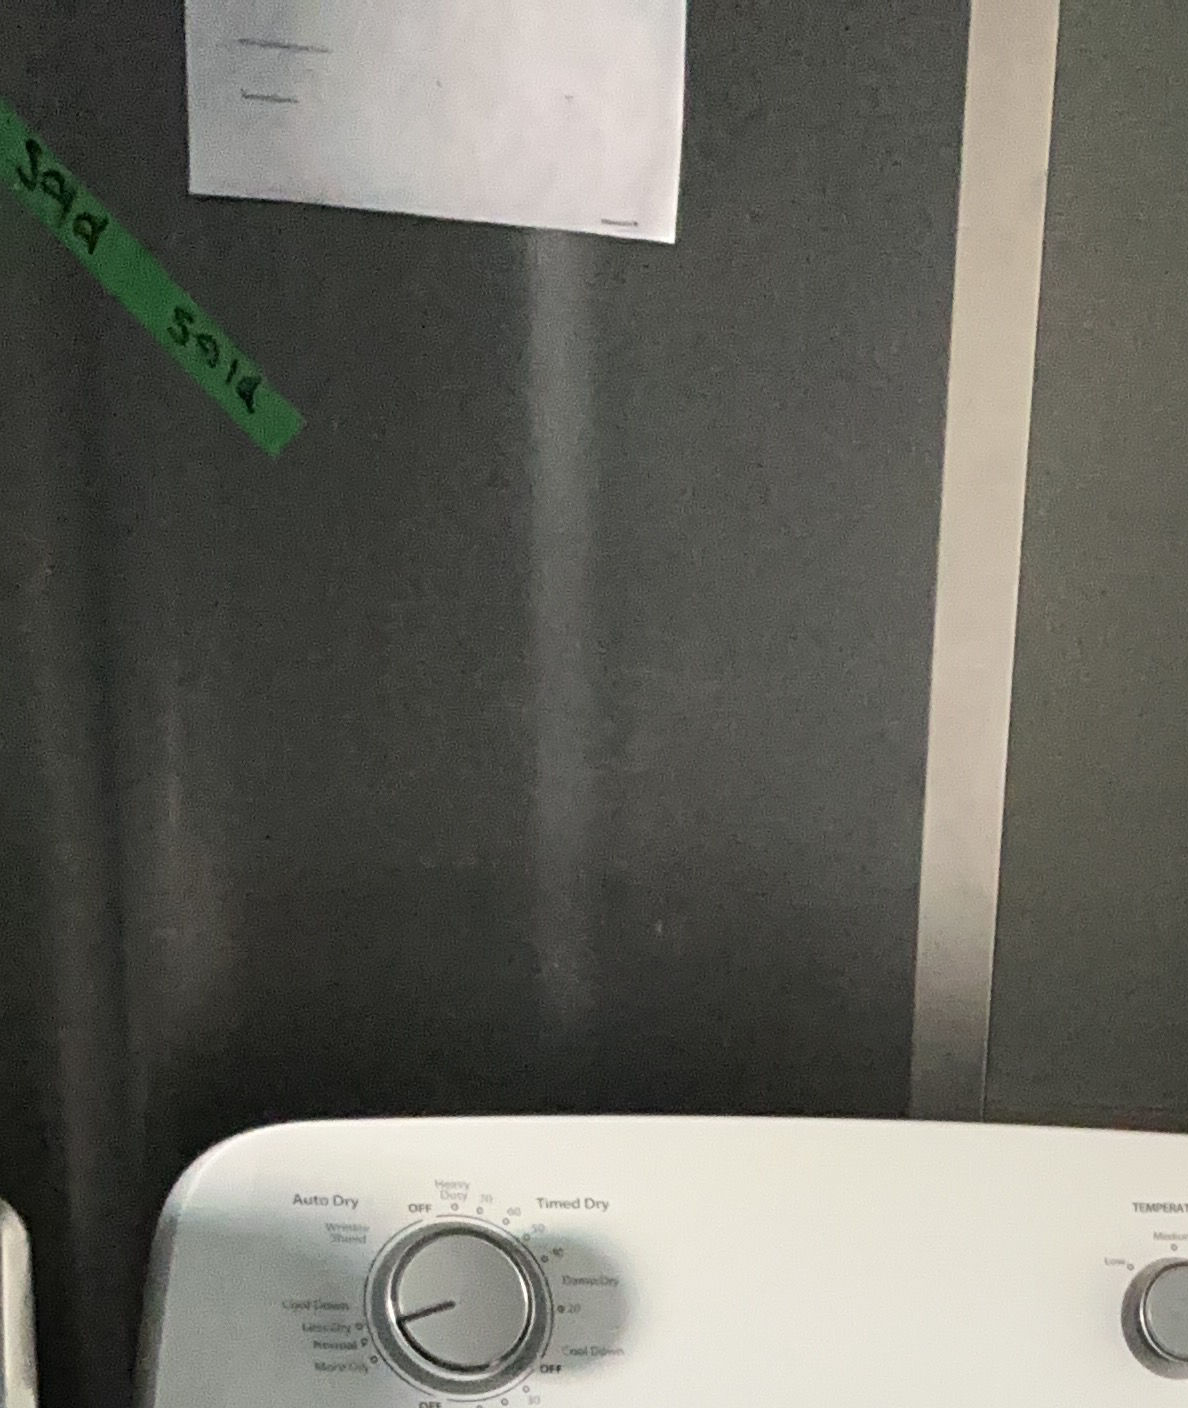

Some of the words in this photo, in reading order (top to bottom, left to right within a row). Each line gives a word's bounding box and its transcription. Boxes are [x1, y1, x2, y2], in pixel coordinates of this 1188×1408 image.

[293, 1194, 329, 1206] Auto
[333, 1195, 359, 1209] Dry
[537, 1197, 580, 1209] Timed
[584, 1198, 609, 1212] Dry
[408, 1203, 432, 1213] OFF
[1104, 1257, 1126, 1266] Low
[540, 1364, 562, 1374] OFF
